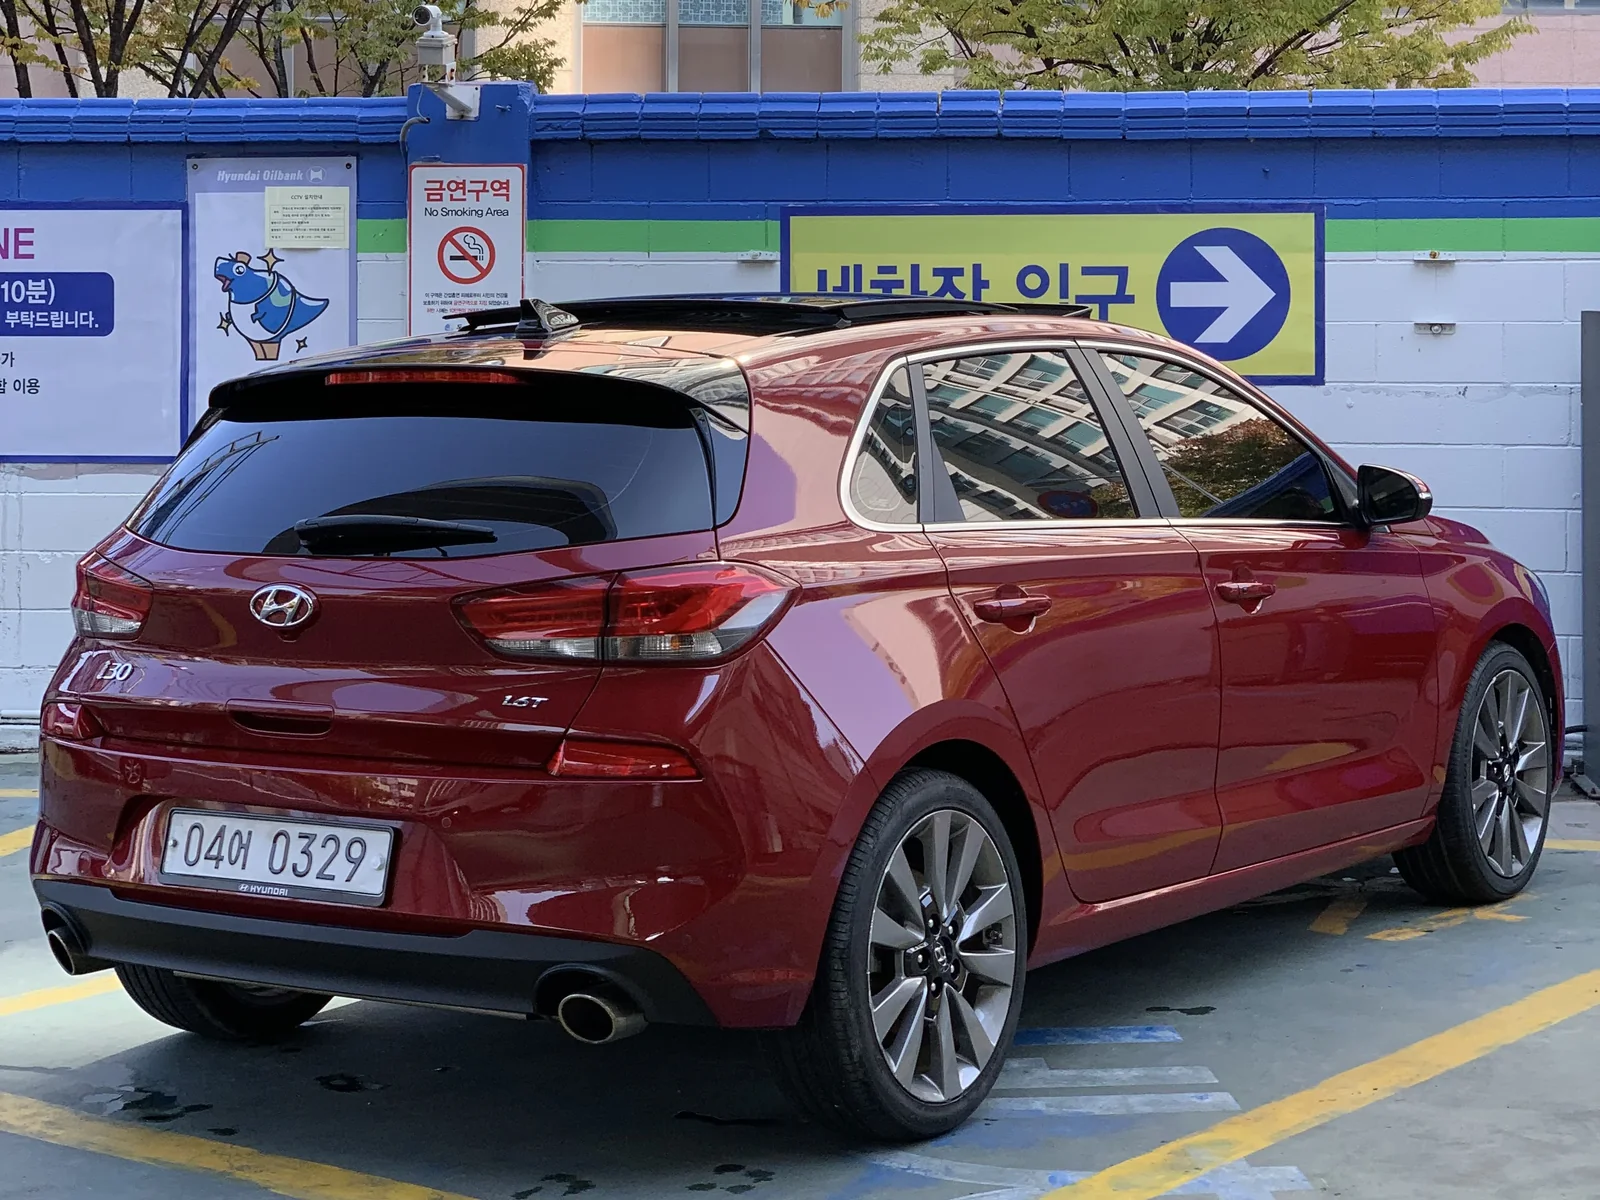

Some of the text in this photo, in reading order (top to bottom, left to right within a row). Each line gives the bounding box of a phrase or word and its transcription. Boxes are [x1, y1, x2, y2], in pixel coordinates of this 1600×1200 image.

[216, 169, 304, 184] Hyundai Oilbank
[423, 179, 510, 202] 금연구역
[424, 206, 509, 218] No Smoking Area
[1016, 262, 1135, 322] 입구
[4, 310, 99, 328] 부탁드립니다.
[13, 378, 40, 394] 이용
[97, 660, 132, 680] i30
[184, 822, 367, 883] 04어 0329
[250, 884, 288, 897] HYUNDAI
